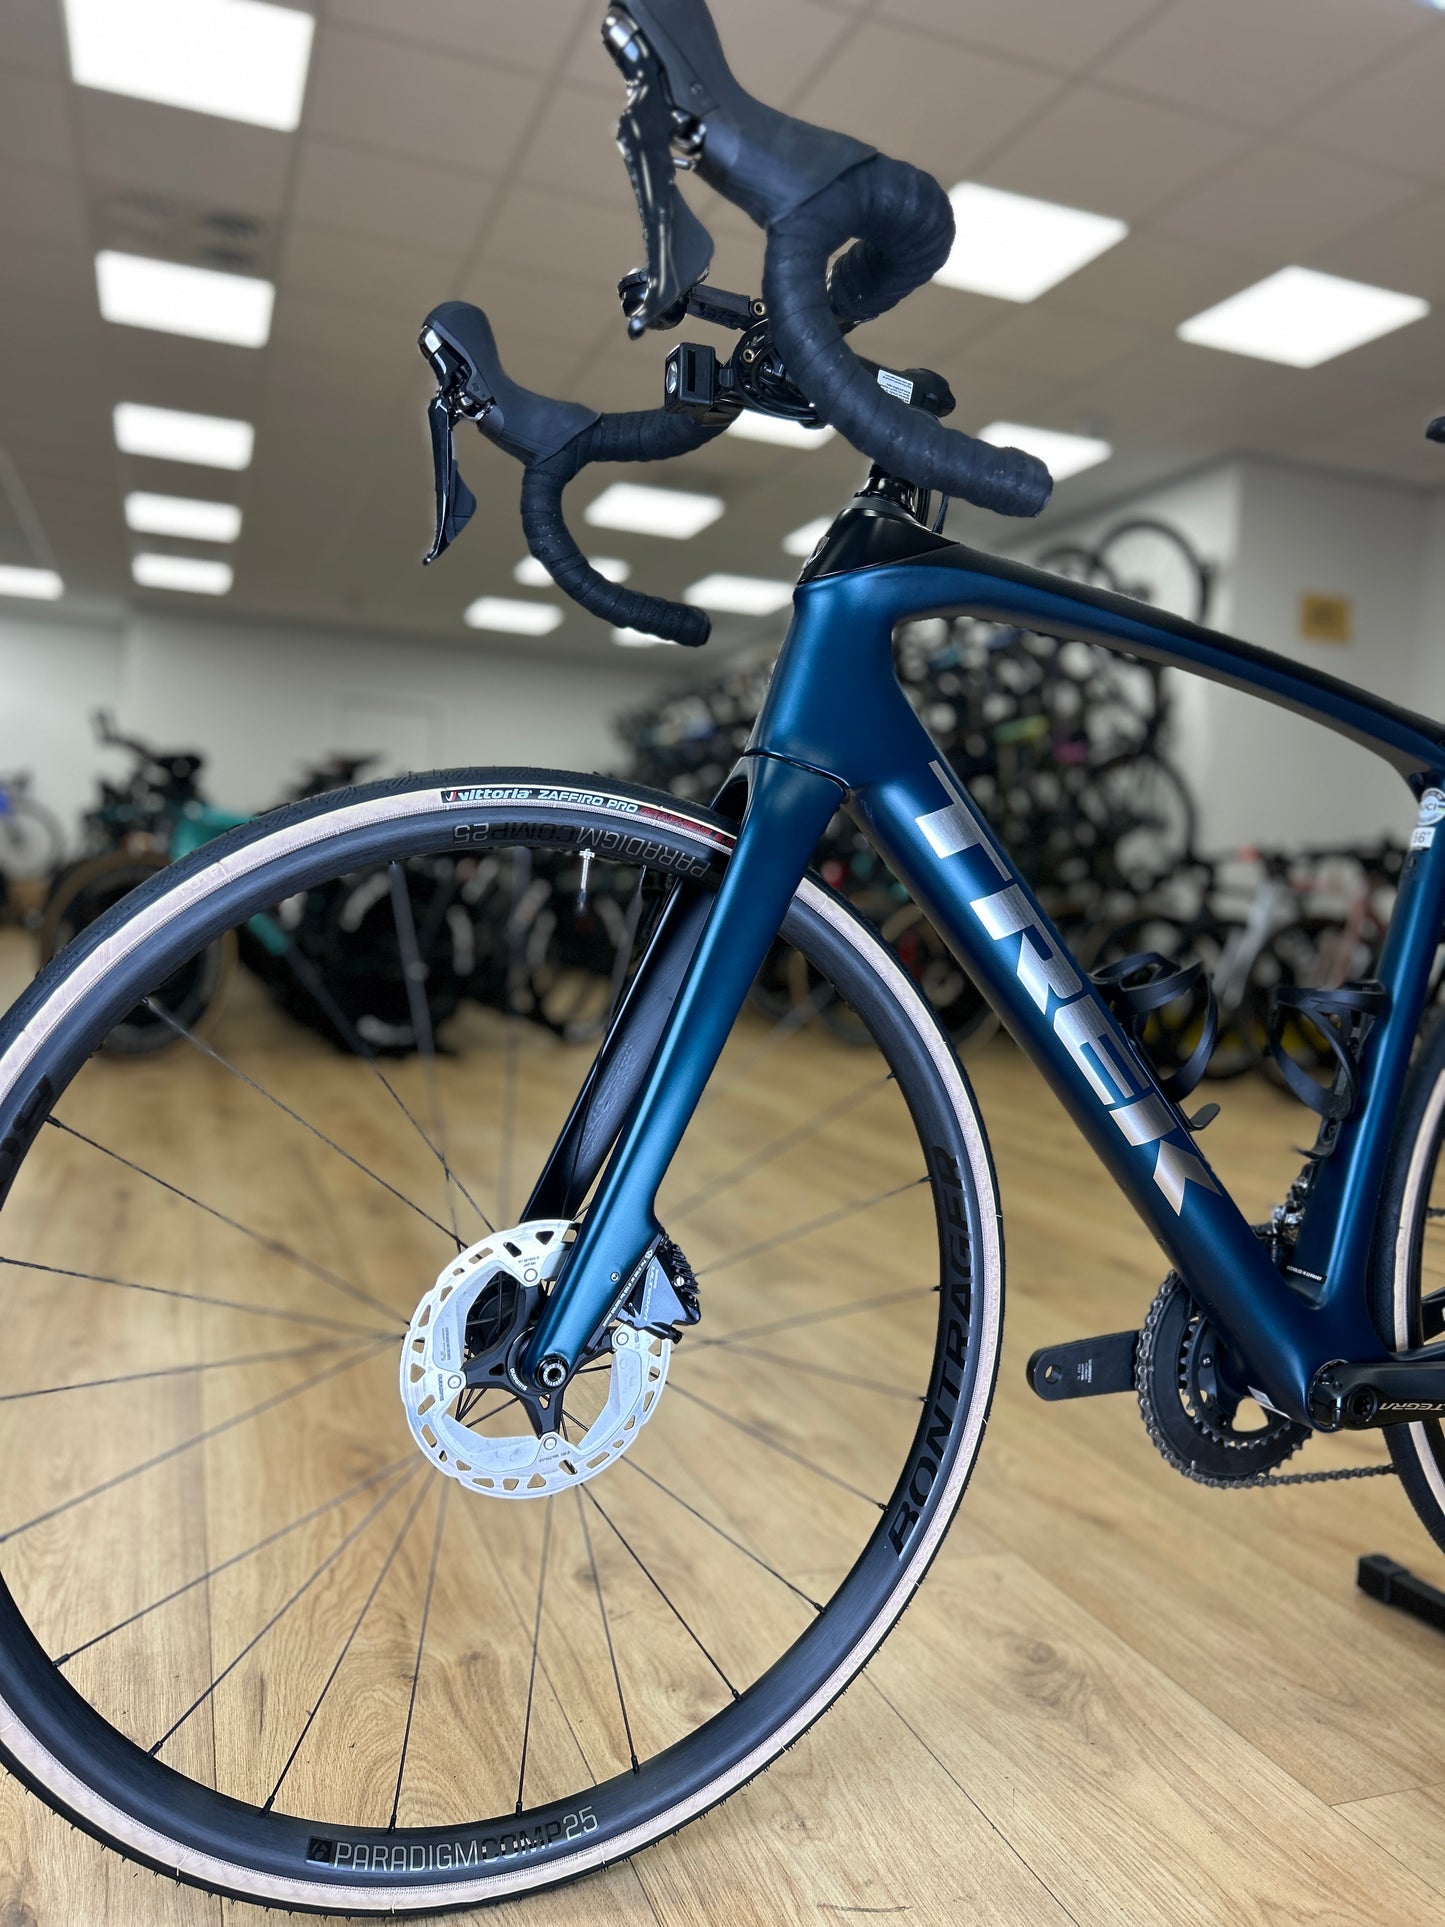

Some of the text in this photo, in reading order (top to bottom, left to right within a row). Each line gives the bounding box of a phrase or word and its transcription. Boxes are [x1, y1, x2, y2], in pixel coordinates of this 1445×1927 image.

[458, 789, 533, 801] vittoria
[538, 790, 605, 806] ZAFFIRO
[606, 800, 639, 813] PRO
[454, 823, 489, 844] 25
[576, 827, 711, 879] PARADIGM
[915, 760, 1222, 1216] TREK
[888, 1146, 973, 1560] BONTRAGER
[1379, 1402, 1445, 1411] TEGRA
[334, 1841, 479, 1872] PARADIGM
[562, 1806, 600, 1841] 25
